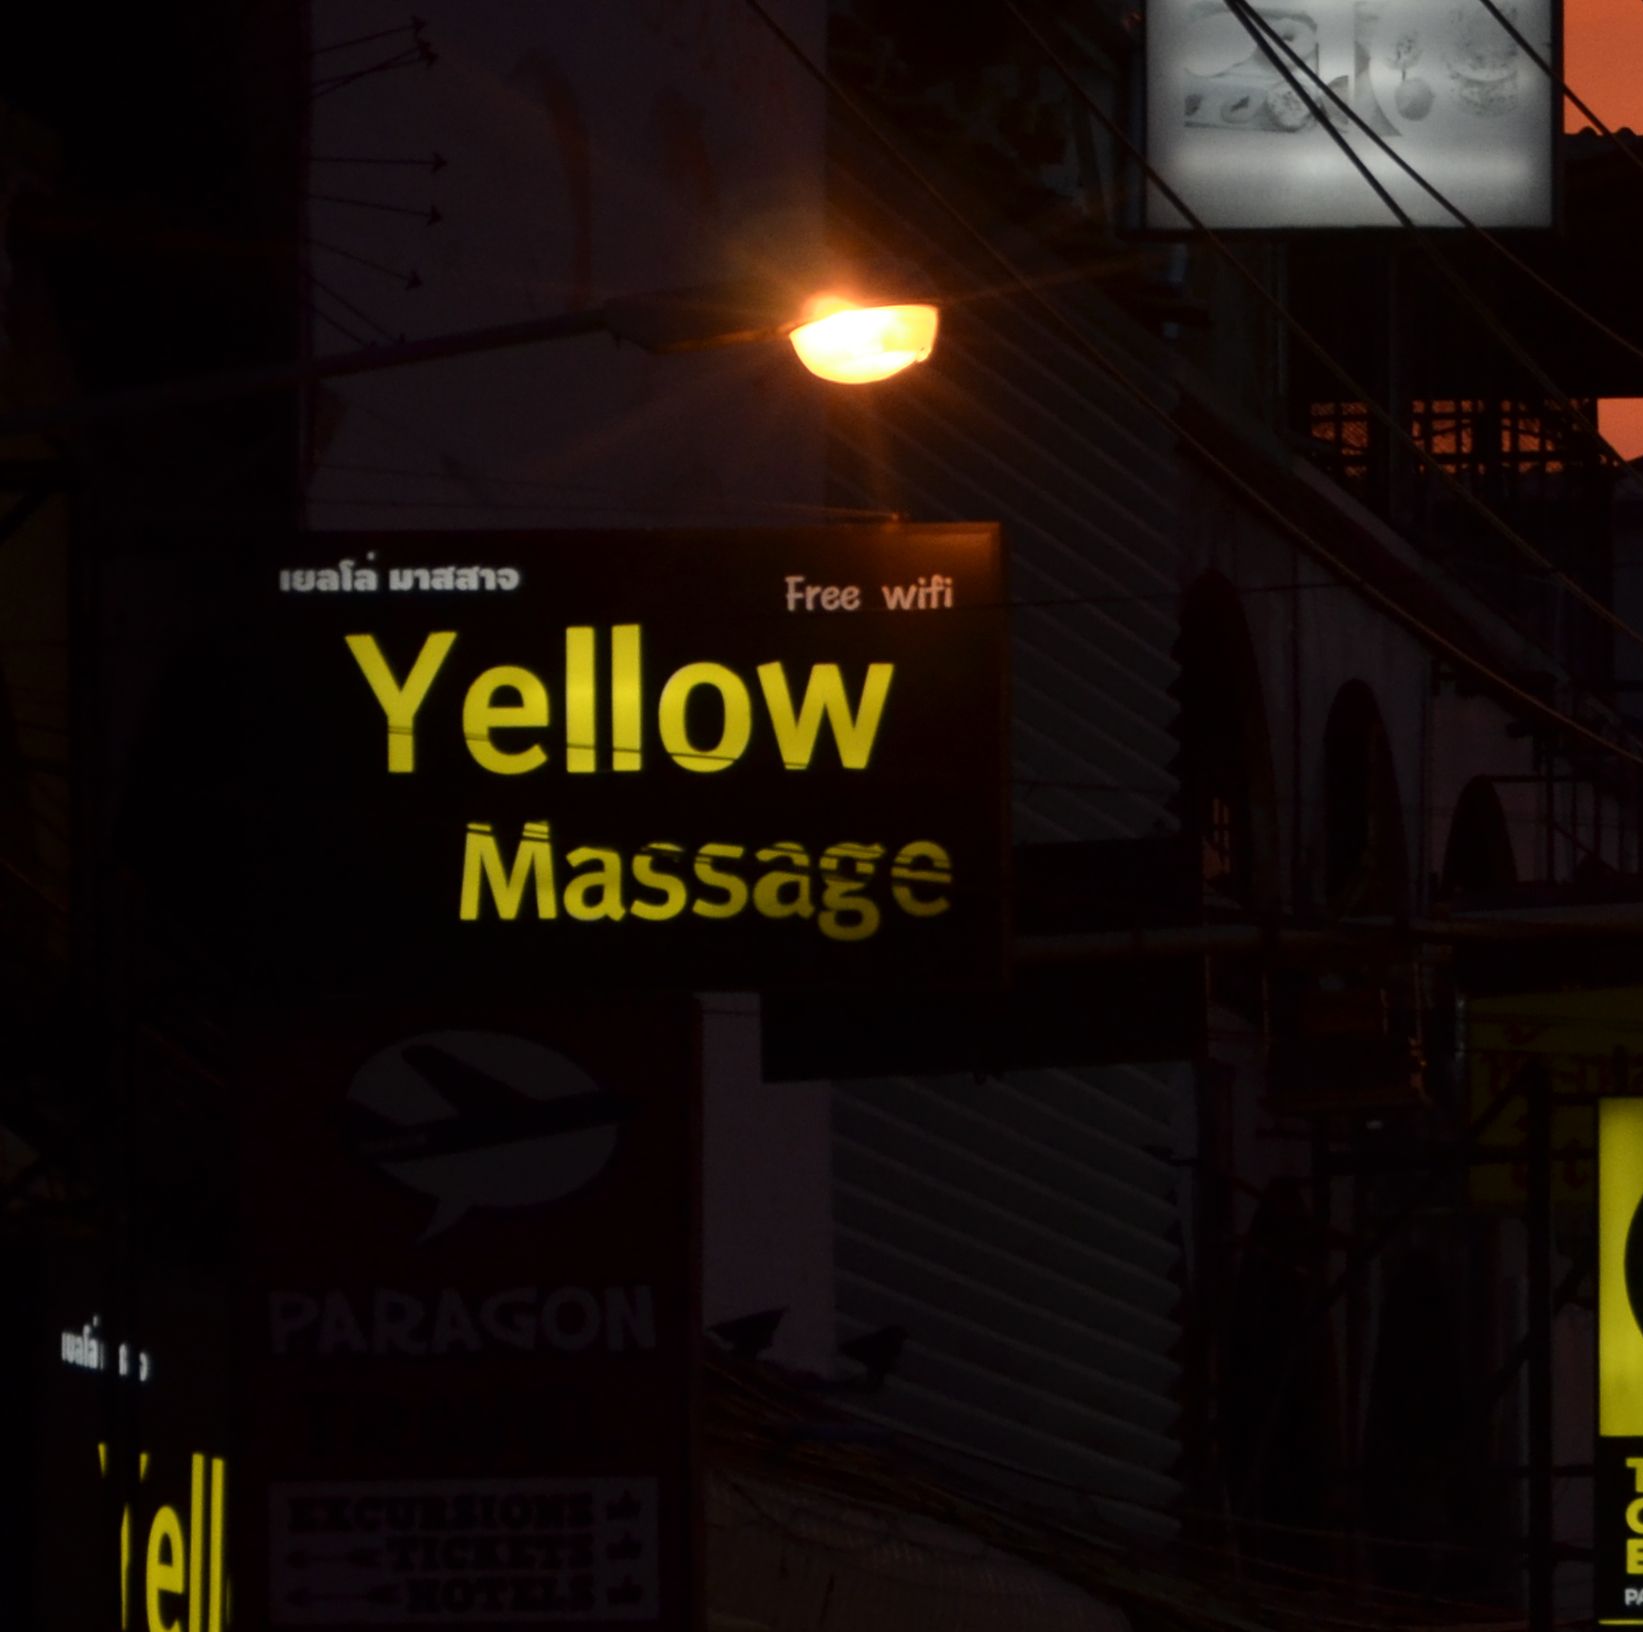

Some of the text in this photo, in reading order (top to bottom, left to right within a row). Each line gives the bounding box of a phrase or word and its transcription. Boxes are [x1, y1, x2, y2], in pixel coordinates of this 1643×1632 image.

[784, 574, 955, 612] Free wifi
[344, 622, 895, 774] Yellow
[457, 820, 955, 942] Massage
[267, 1284, 657, 1356] PARAGON
[288, 1493, 594, 1531] EXCURSIONS
[387, 1534, 594, 1571] TICKETS
[404, 1577, 594, 1612] HOTELS
